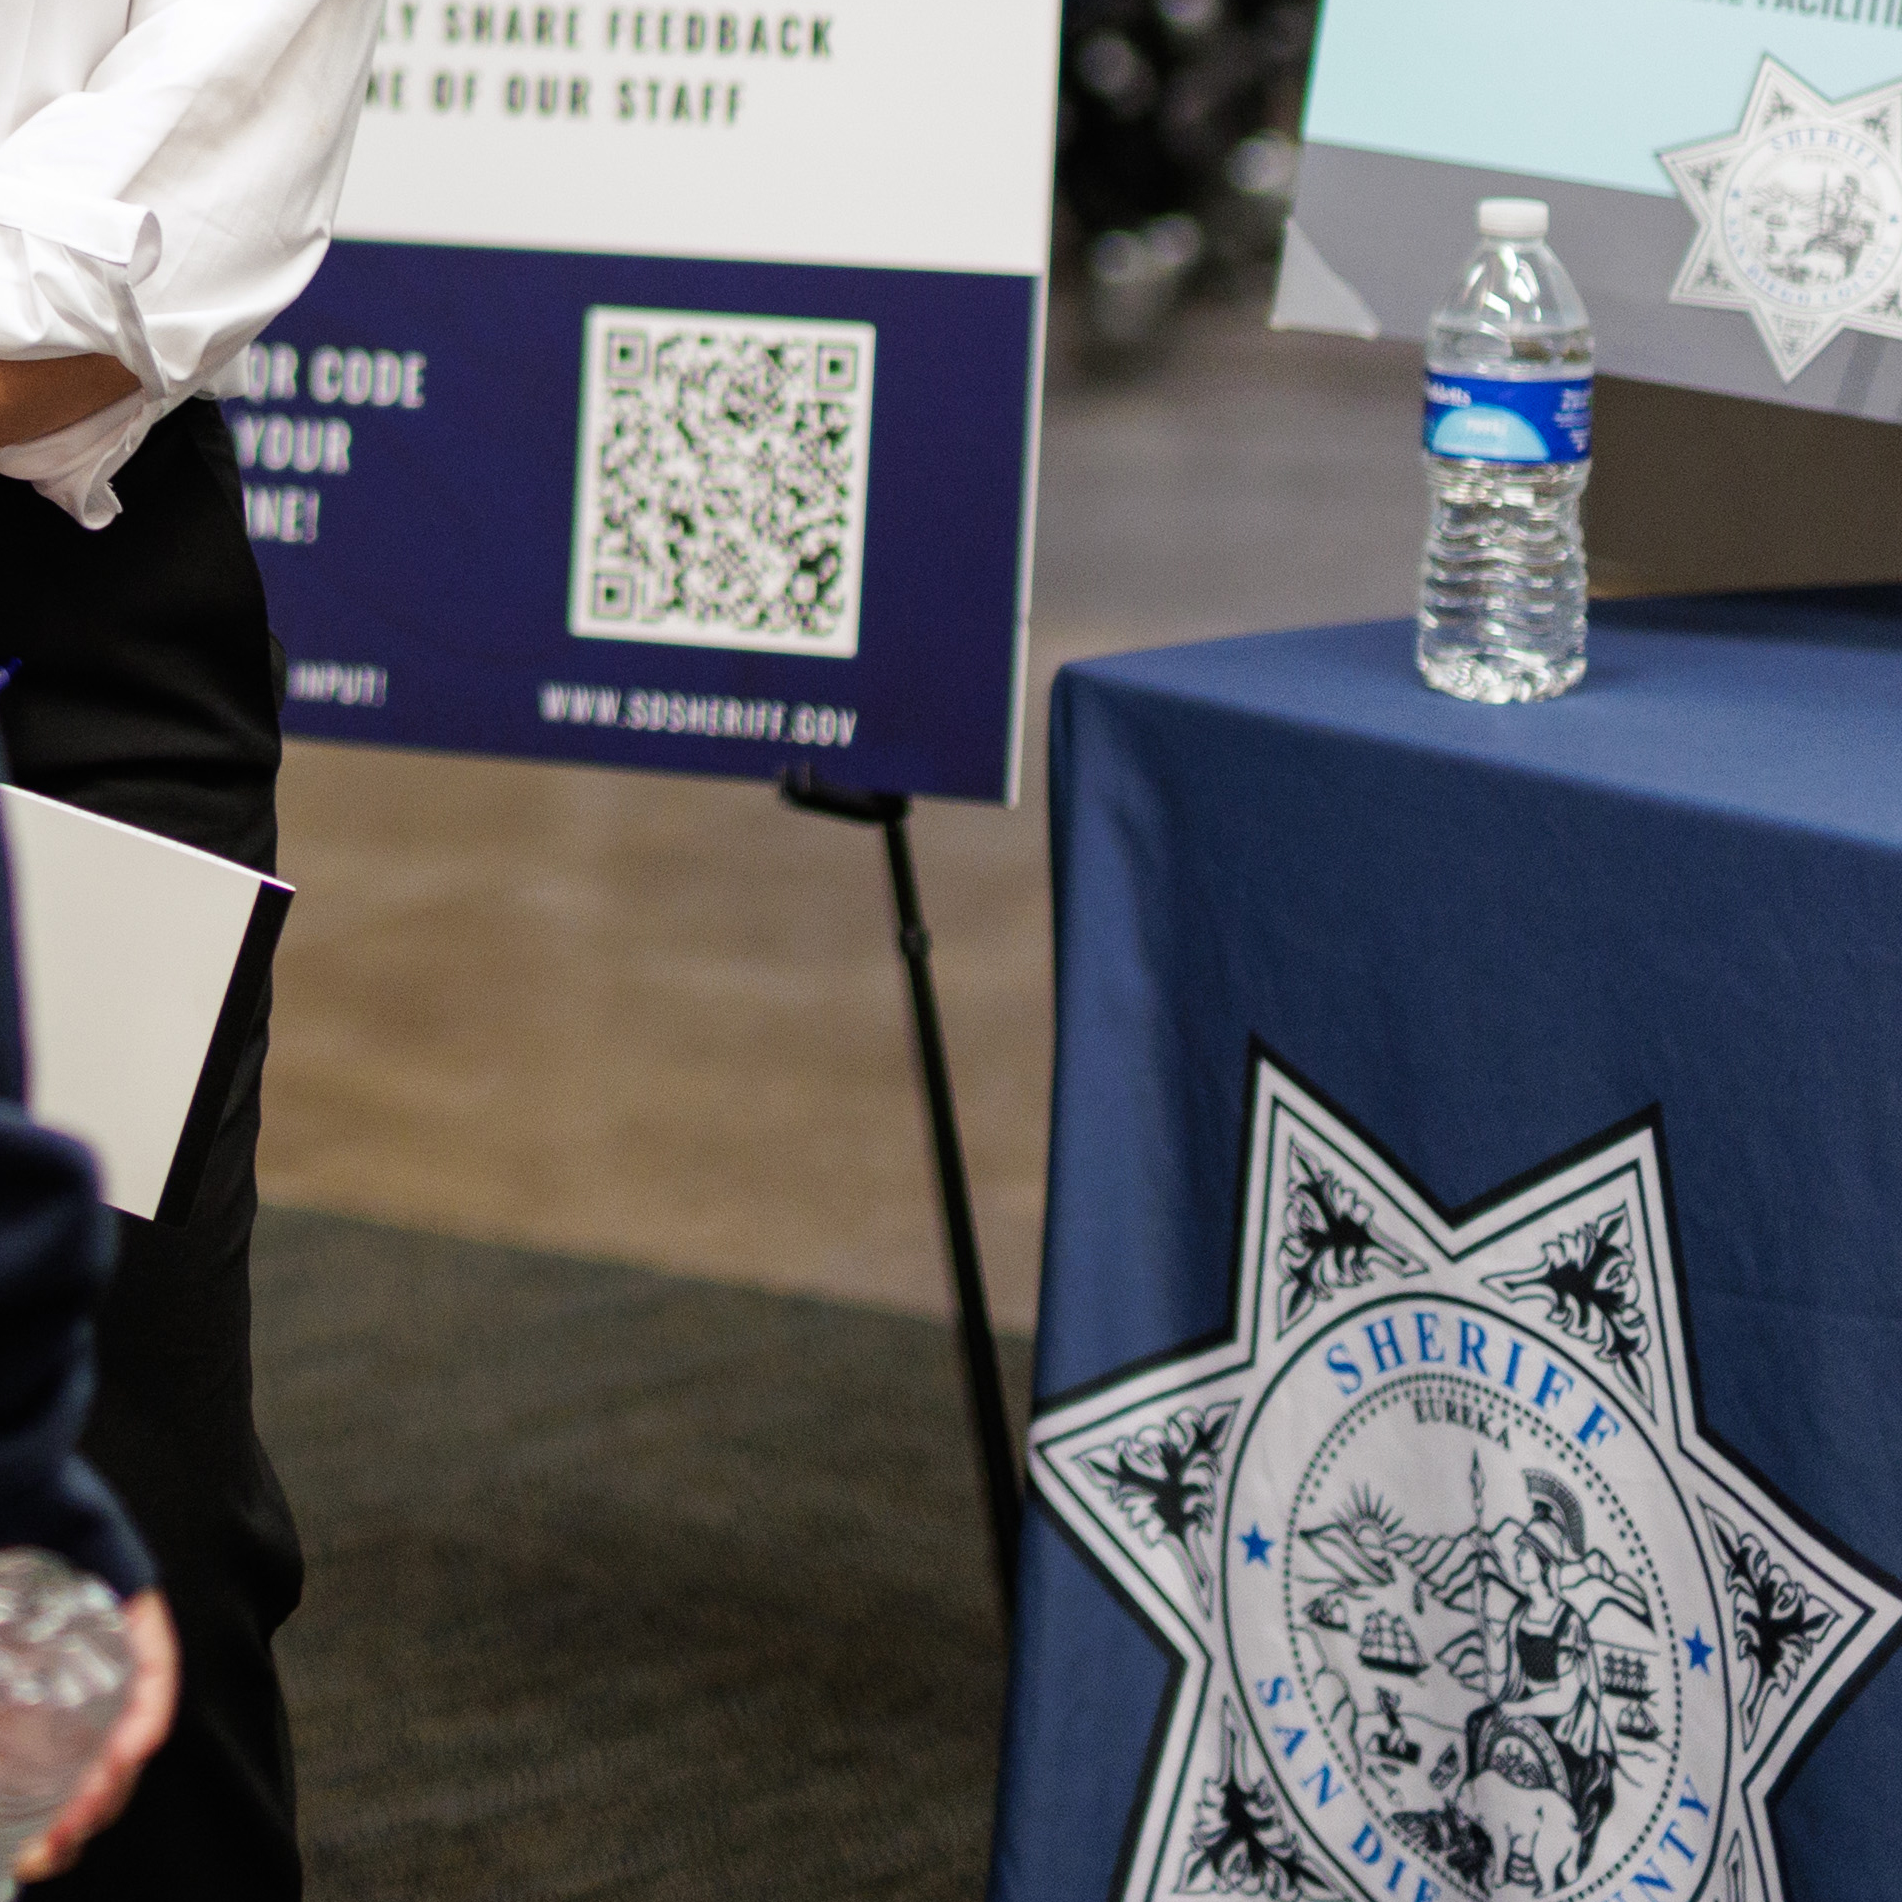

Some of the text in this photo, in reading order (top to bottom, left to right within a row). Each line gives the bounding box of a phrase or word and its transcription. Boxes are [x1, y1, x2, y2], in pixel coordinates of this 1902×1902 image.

[444, 4, 581, 46] SHARE
[608, 7, 832, 57] FEEDBACK
[433, 72, 478, 111] OF
[506, 74, 589, 117] OUR
[617, 80, 743, 123] STAFF
[309, 344, 427, 409] CODE
[234, 412, 352, 475] YOUR
[1325, 1311, 1621, 1449] SHERIFF
[1414, 1399, 1511, 1450] EUREKA
[1254, 1675, 1346, 1810] SAN
